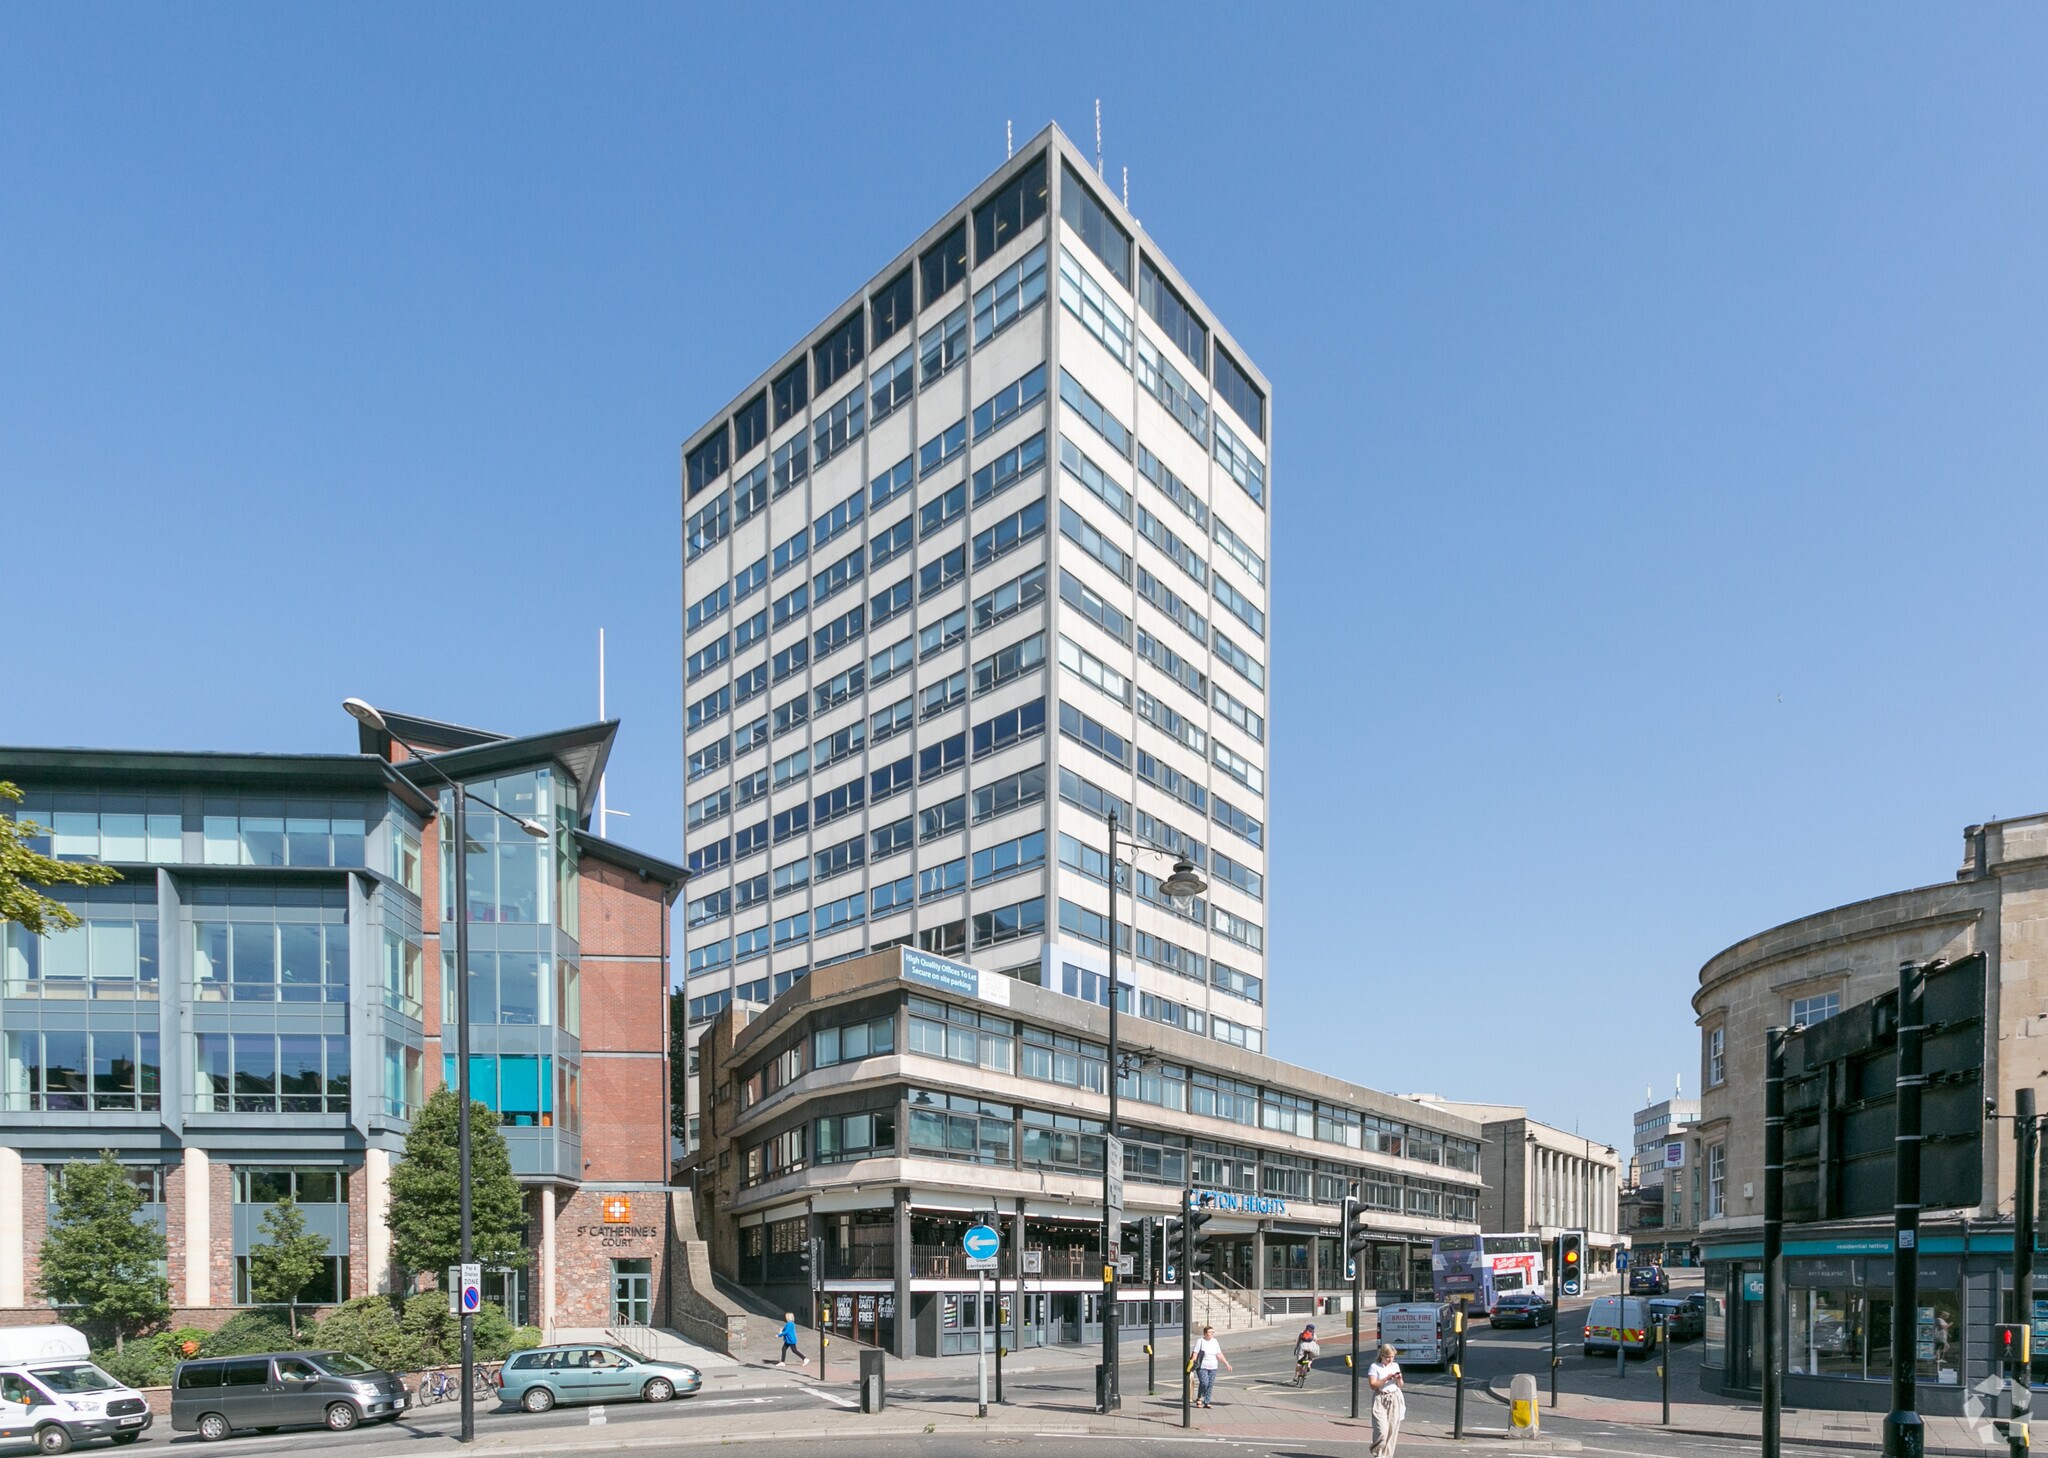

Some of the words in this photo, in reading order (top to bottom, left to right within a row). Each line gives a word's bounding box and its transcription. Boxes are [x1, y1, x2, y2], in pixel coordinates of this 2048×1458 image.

[905, 953, 920, 965] High
[920, 958, 941, 972] Quality
[941, 964, 960, 977] Offices
[960, 970, 968, 979] To
[968, 972, 977, 982] Let
[911, 966, 931, 978] Secure
[931, 973, 940, 981] on
[940, 975, 951, 984] site
[950, 978, 972, 991] parking
[1242, 1194, 1285, 1214] HEIGHTS
[589, 1226, 657, 1237] CATHERINE'S
[601, 1238, 634, 1247] COURT
[836, 1297, 853, 1308] HAPPY
[858, 1298, 875, 1309] PARTY
[837, 1307, 852, 1317] HOUR
[858, 1311, 875, 1322] FREE!
